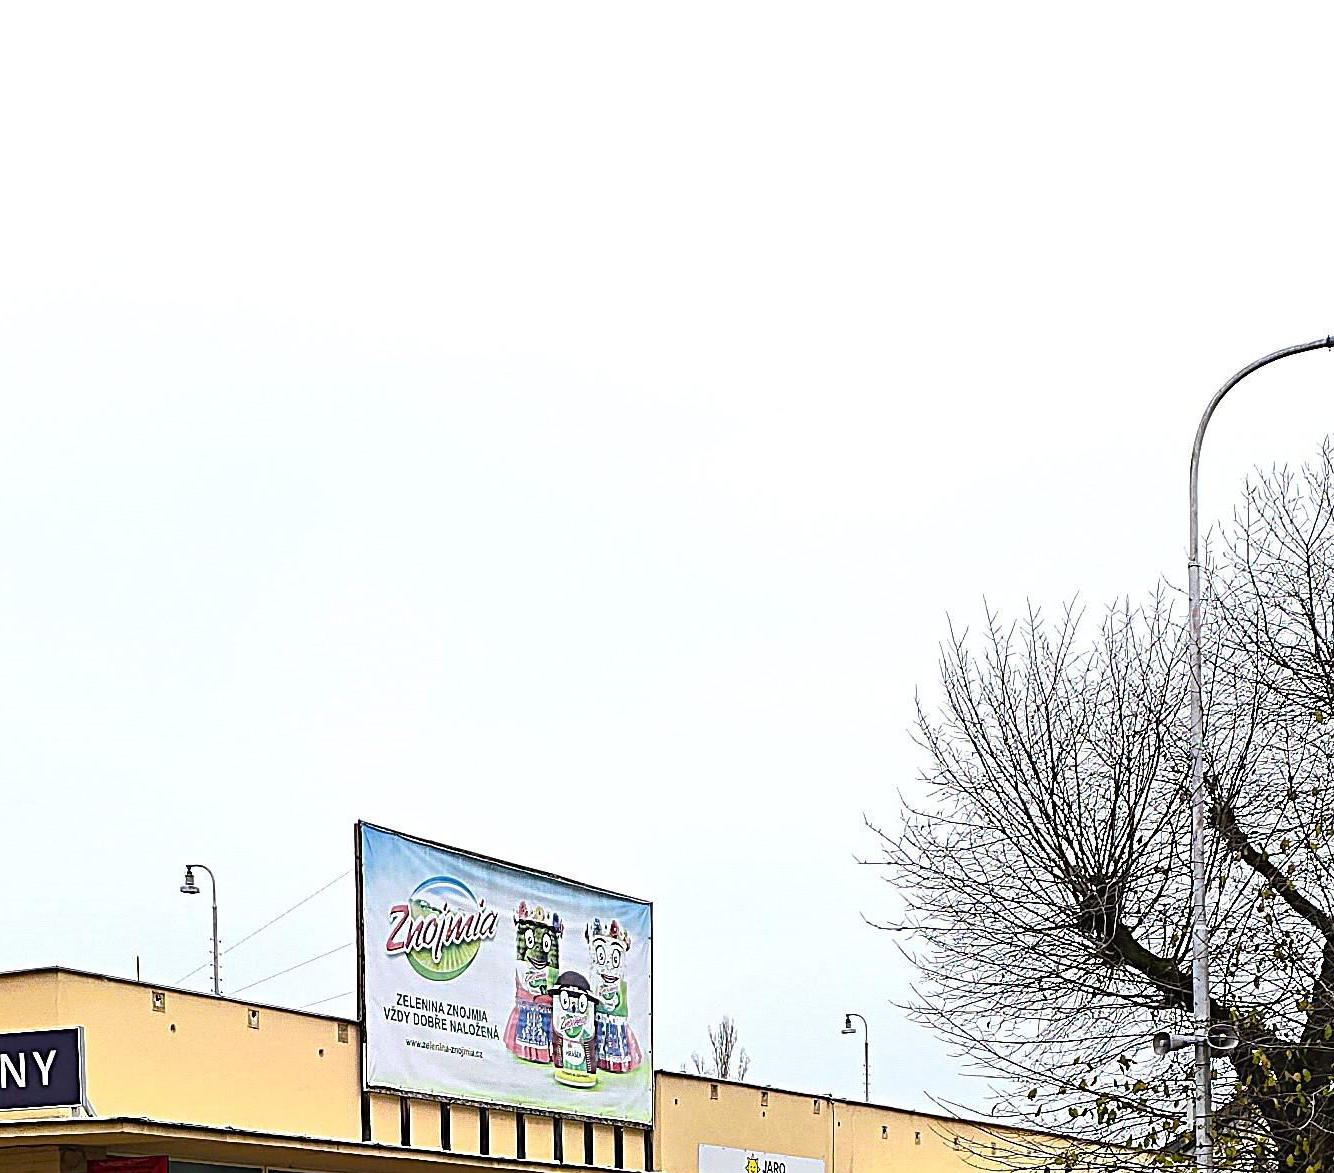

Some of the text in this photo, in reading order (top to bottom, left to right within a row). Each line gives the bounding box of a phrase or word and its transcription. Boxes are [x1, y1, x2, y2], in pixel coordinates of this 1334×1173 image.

[386, 899, 499, 960] Znojmia
[383, 1006, 500, 1041] VŽDY DOBŘE NALOŽENÁ
[396, 993, 488, 1023] ZELENINA ZNOJMIA
